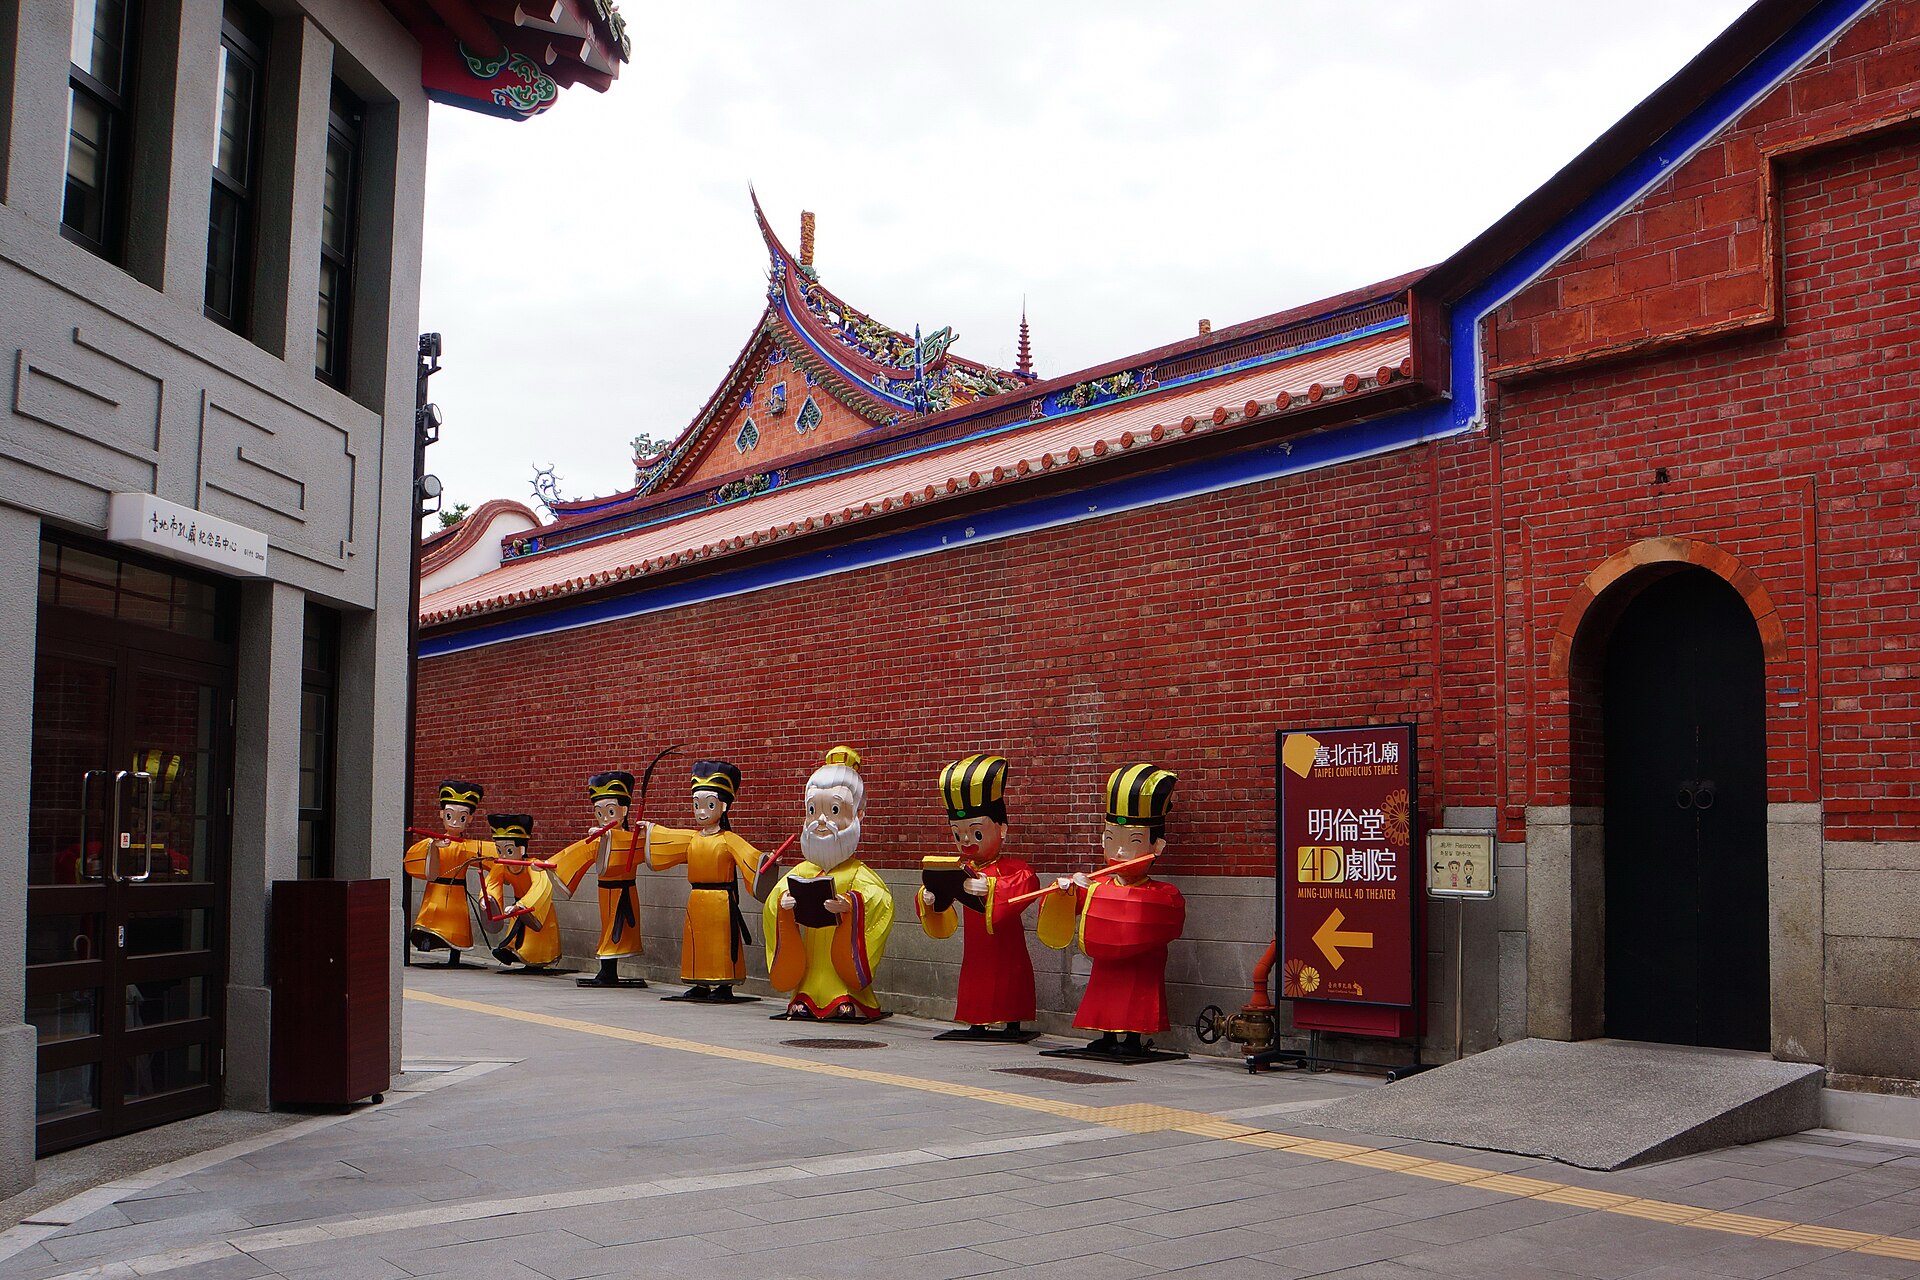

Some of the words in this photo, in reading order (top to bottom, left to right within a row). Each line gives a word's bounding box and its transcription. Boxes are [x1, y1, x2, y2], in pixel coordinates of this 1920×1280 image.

[1313, 741, 1399, 767] 臺北市孔廟
[1314, 768, 1334, 778] TAIPEI
[1335, 765, 1372, 777] CONFUCIUS
[1374, 764, 1399, 775] TEMPLE
[1308, 808, 1385, 841] 明倫堂
[1297, 887, 1333, 899] MING-LUN
[1334, 888, 1353, 899] HALL
[1354, 888, 1364, 899] 4D
[1365, 888, 1396, 900] THEATER
